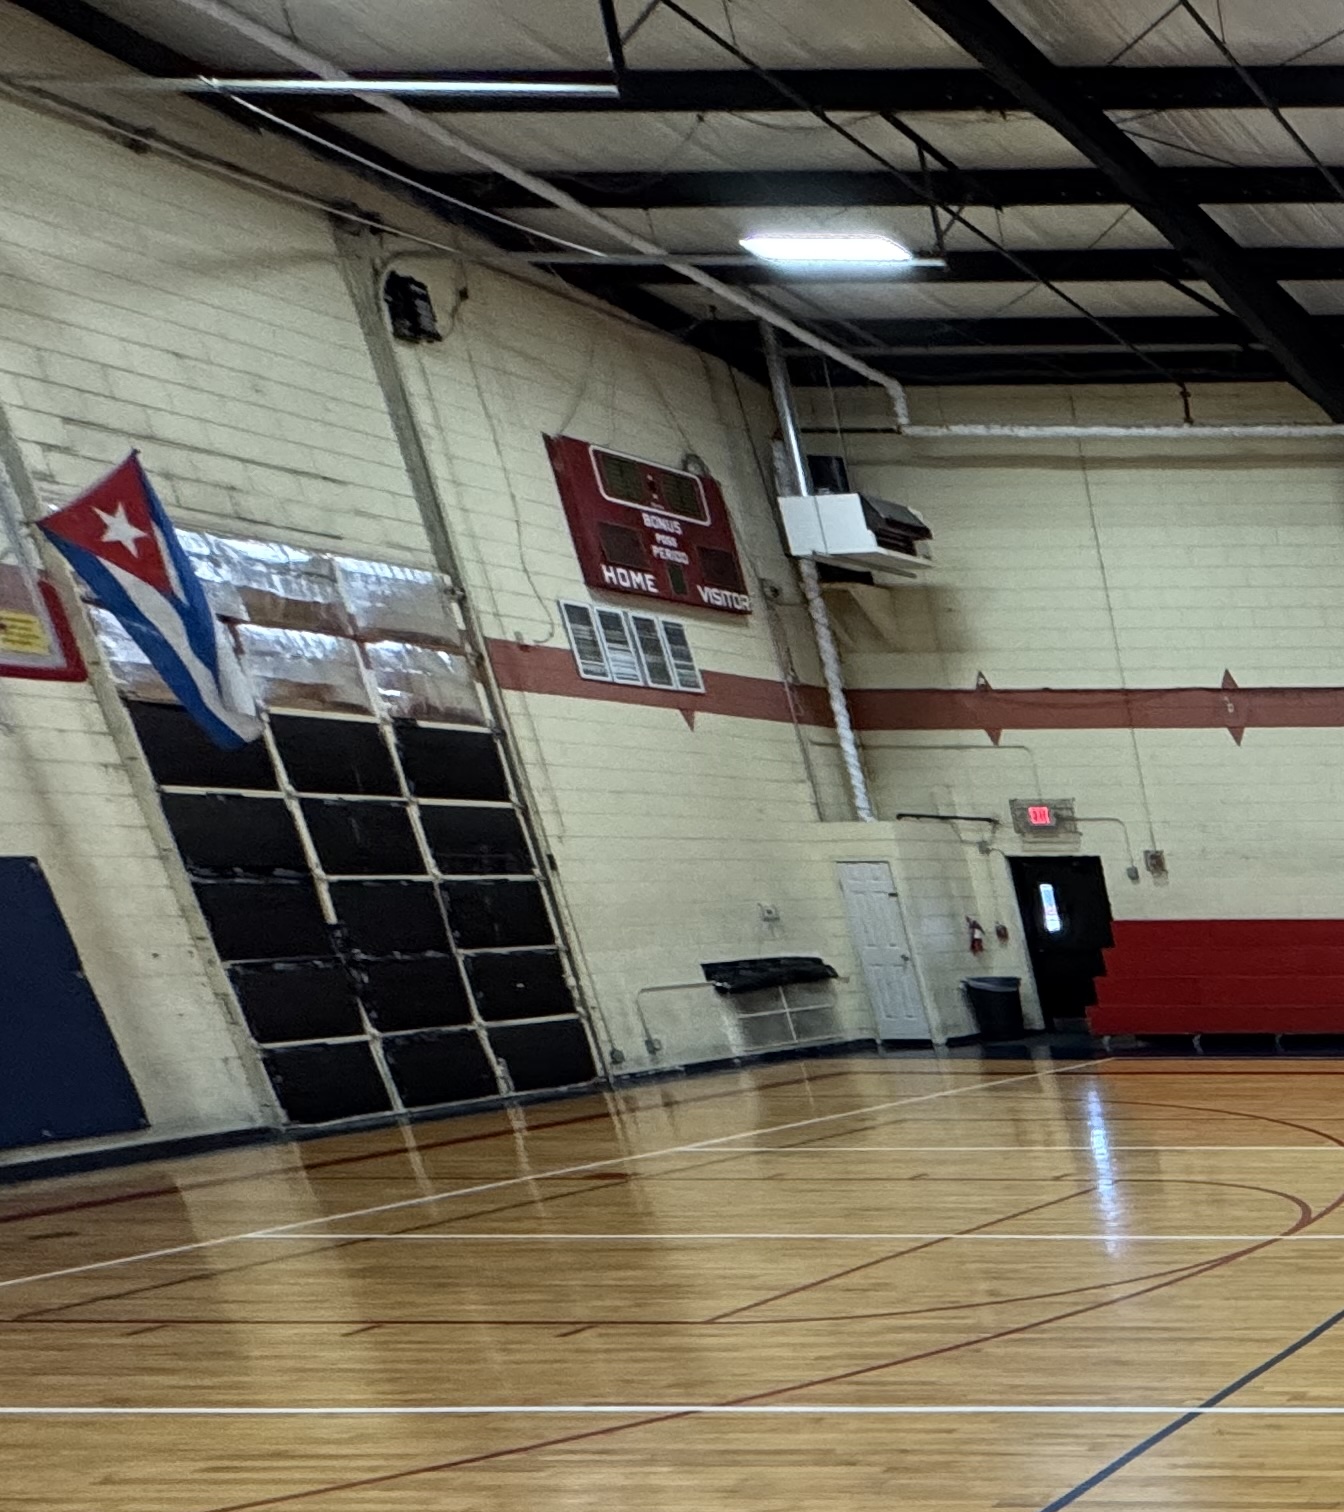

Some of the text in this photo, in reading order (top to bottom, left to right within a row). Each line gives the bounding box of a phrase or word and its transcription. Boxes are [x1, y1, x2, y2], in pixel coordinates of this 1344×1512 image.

[641, 512, 682, 535] BONUS
[651, 544, 689, 565] PERIOD
[601, 564, 659, 593] HOME
[697, 585, 750, 610] VISITOR
